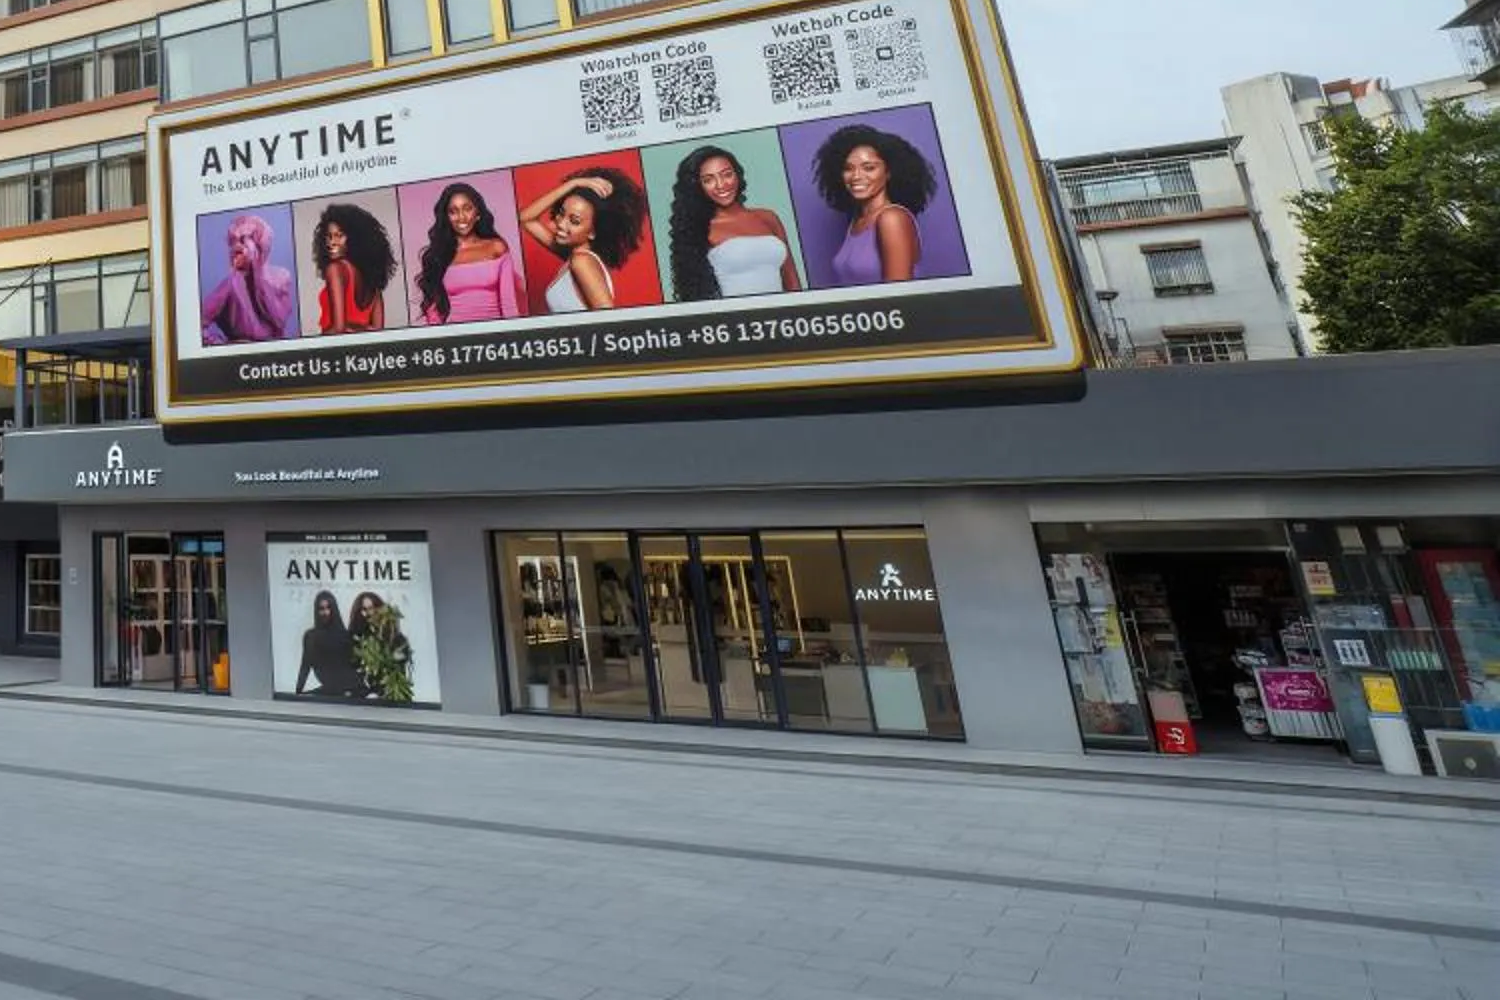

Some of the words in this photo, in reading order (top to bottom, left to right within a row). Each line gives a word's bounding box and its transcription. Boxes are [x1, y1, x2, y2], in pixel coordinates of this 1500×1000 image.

[846, 4, 895, 23] Code
[665, 40, 708, 59] Code
[201, 113, 396, 177] ANYTIME
[239, 362, 305, 381] Contact
[309, 357, 331, 376] Us
[345, 351, 408, 375] Kaylee
[411, 347, 446, 366] +86
[450, 336, 584, 364] 17764143651
[604, 327, 682, 353] Sophia
[687, 322, 730, 345] +86
[736, 308, 905, 343] 13760656006
[75, 468, 158, 487] ANYTIME
[286, 559, 412, 581] ANYTIME
[854, 588, 936, 602] ANYTIME
